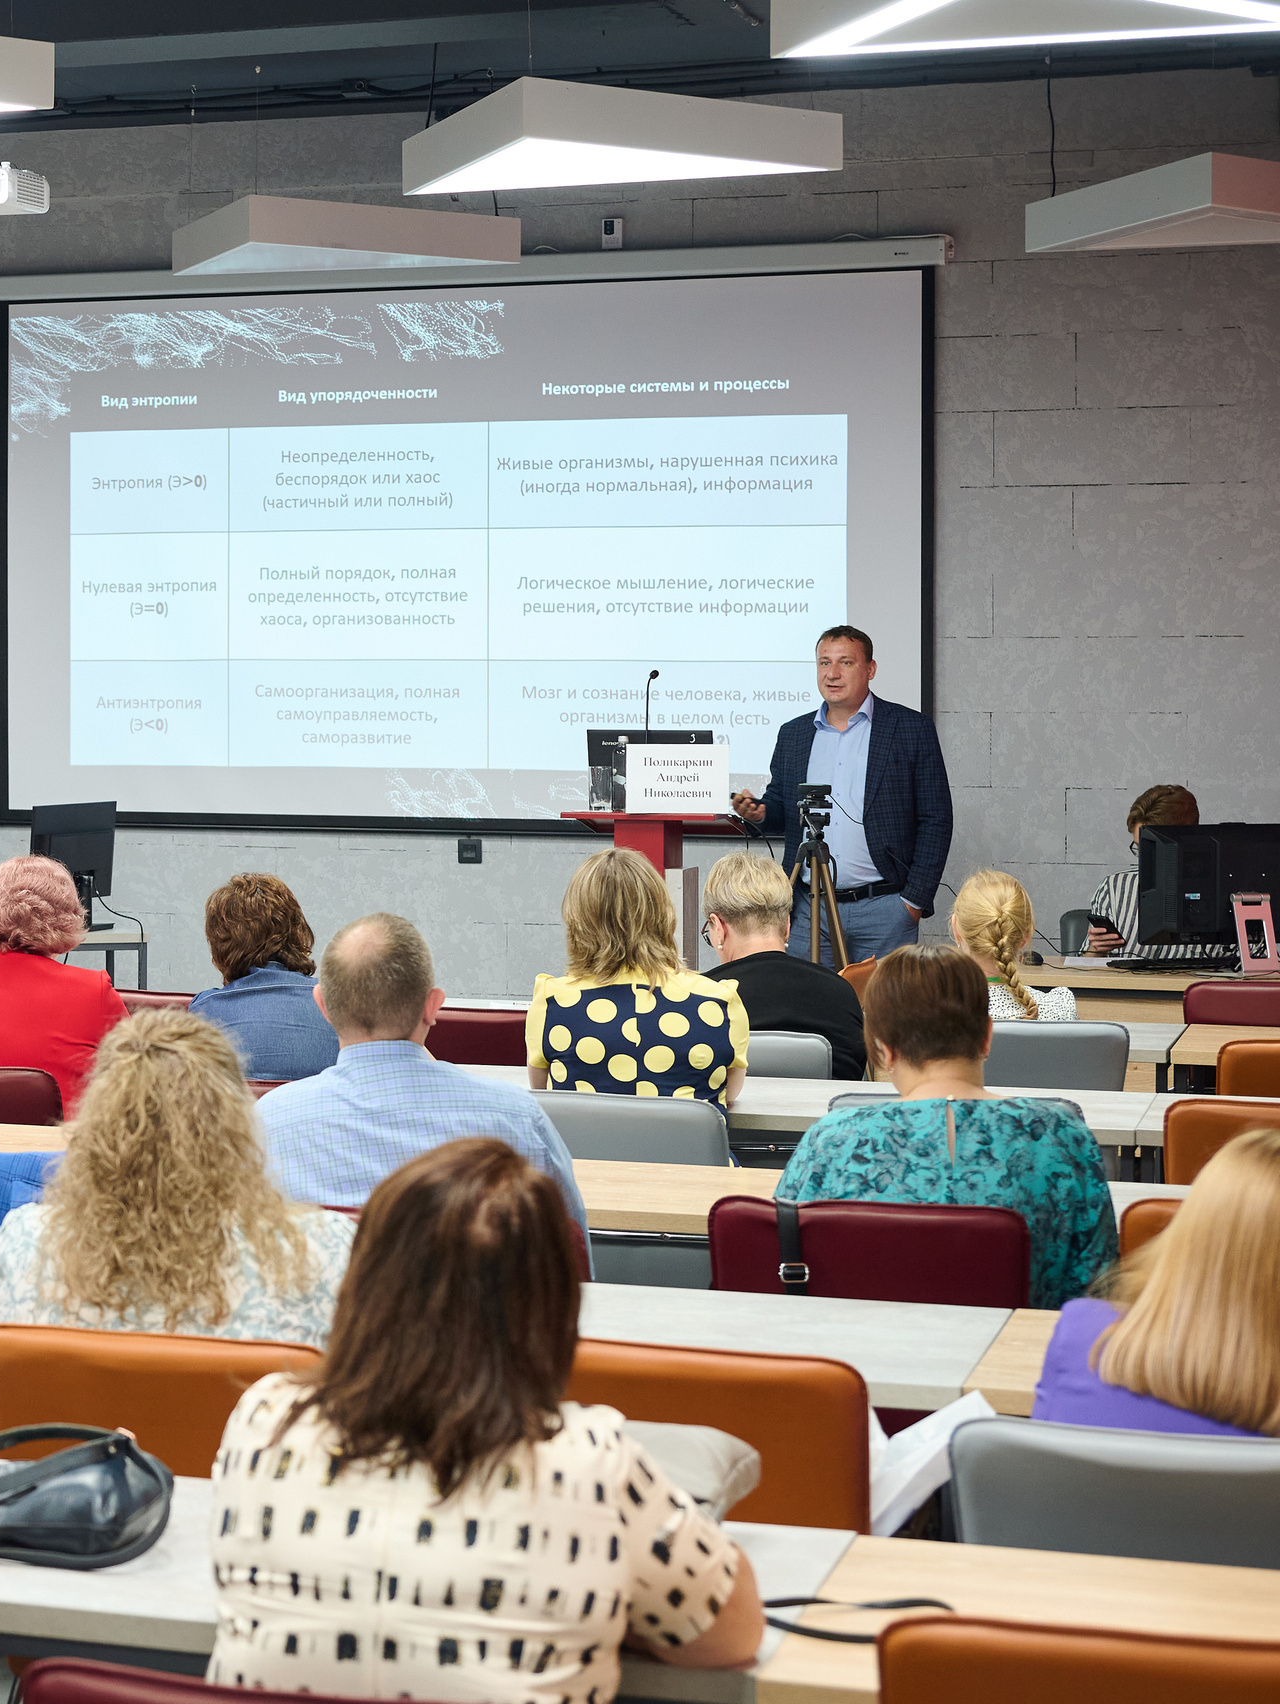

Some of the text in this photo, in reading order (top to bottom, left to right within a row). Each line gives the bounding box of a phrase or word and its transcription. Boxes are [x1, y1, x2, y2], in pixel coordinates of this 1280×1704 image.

[278, 385, 438, 406] Вид упорядоченности
[542, 376, 790, 397] Некоторые системы и процессы
[101, 392, 198, 409] Вид энтропии
[281, 447, 436, 465] Неопределенность,
[496, 450, 838, 471] Живые организмы, нарушенная психика
[91, 473, 208, 493] Энтропия (Э>0)
[275, 469, 440, 489] беспорядок или хаос
[519, 475, 813, 497] (иногда нормальная), информация
[262, 490, 453, 511] (частичный или полный)
[259, 564, 456, 584] Полный порядок, полная
[517, 574, 815, 593] Логическое мышление, логические
[81, 579, 217, 596] Нулевая энтропия
[248, 587, 468, 607] определенность, отсутствие
[129, 600, 169, 618] (Э=0)
[523, 597, 809, 617] решения, отсутствие информации
[260, 611, 456, 630] хаоса, организованность
[254, 684, 460, 701] Самоорганизация, полная
[522, 685, 811, 704] Мозг и сознание человека, живые
[96, 695, 202, 712] Антиэнтропия
[129, 717, 169, 734] (Э<0)
[276, 707, 439, 726] самоуправляемость,
[559, 709, 770, 729] организмы в целом (есть
[301, 730, 412, 749] саморазвитие
[644, 758, 713, 768] Поликаркин
[656, 773, 700, 783] Андрей
[644, 788, 712, 798] Николаевич
